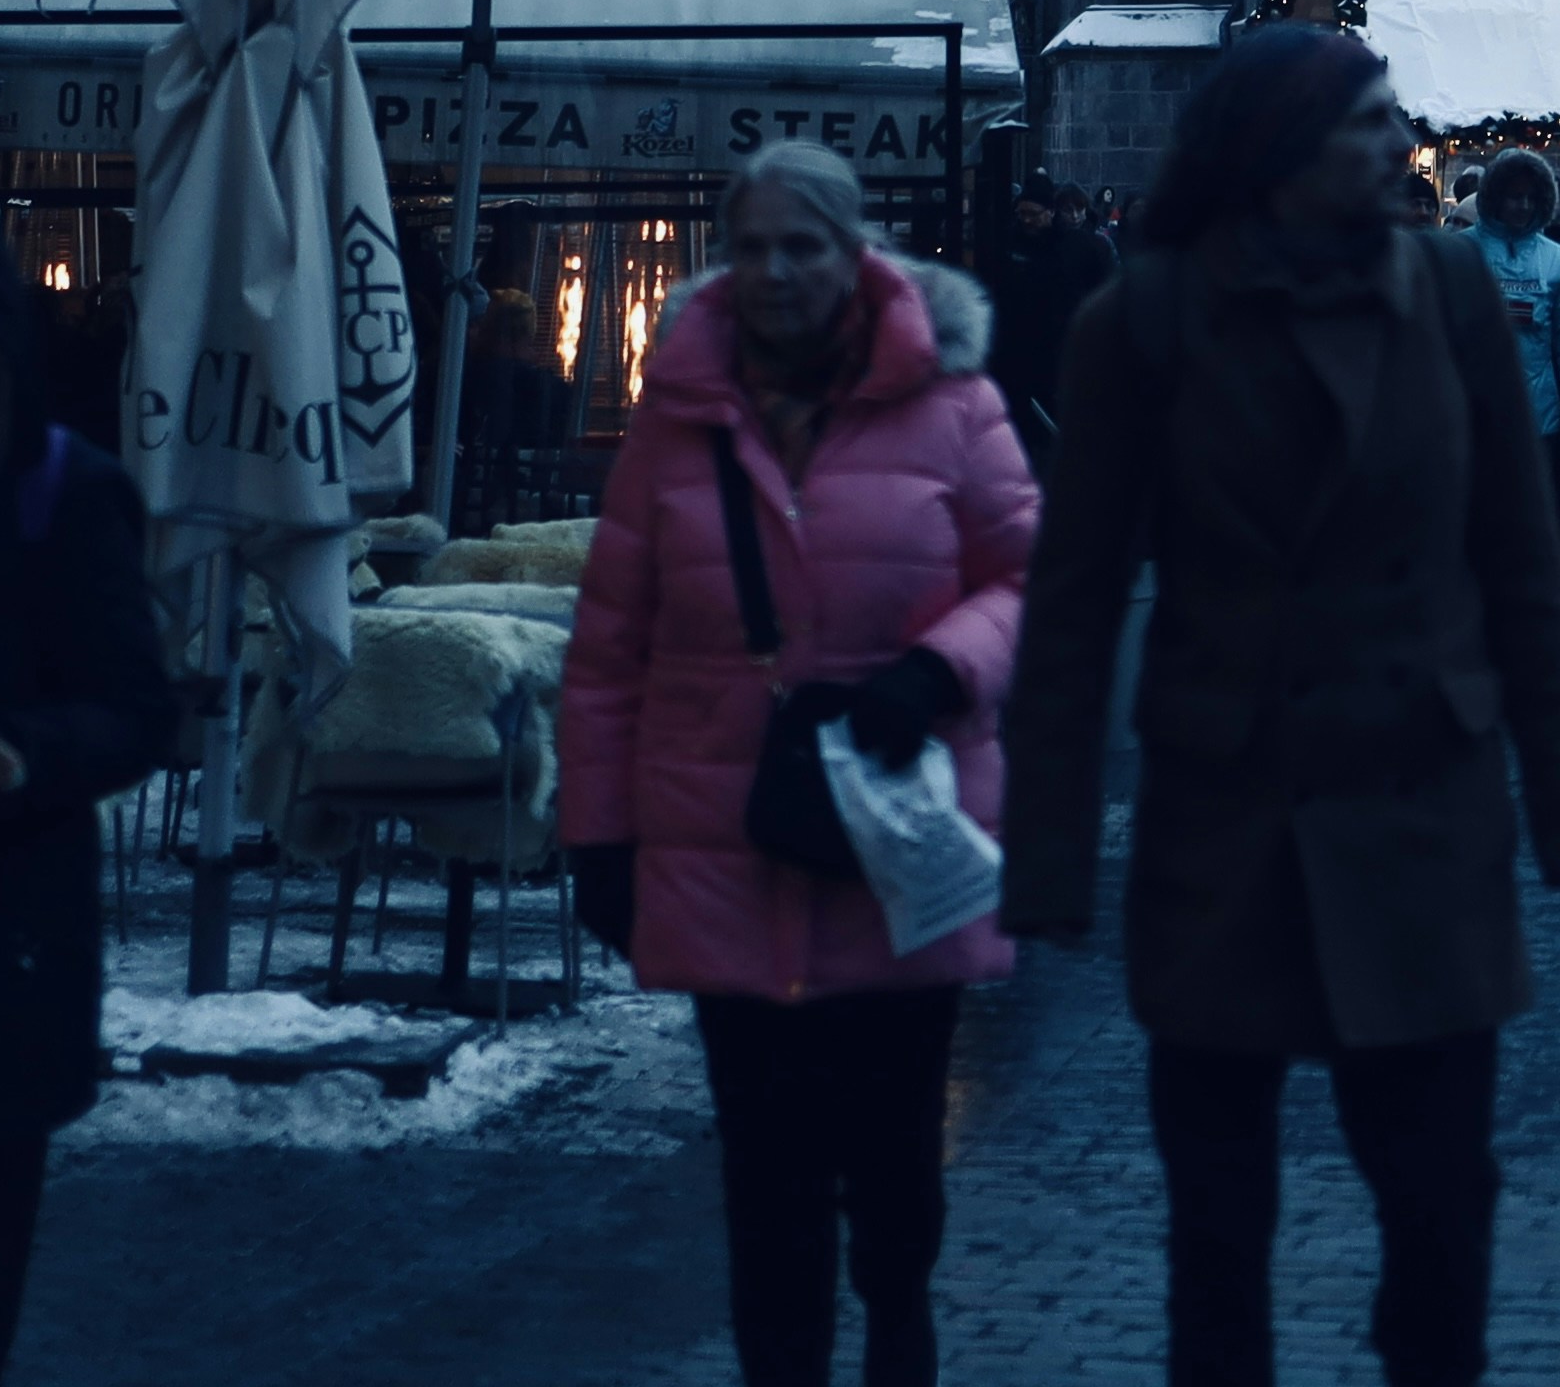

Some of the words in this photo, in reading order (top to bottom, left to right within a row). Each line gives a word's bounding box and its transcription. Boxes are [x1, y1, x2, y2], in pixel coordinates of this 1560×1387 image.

[620, 132, 695, 157] Kozel
[727, 108, 947, 160] STEAK
[341, 309, 410, 354] CP
